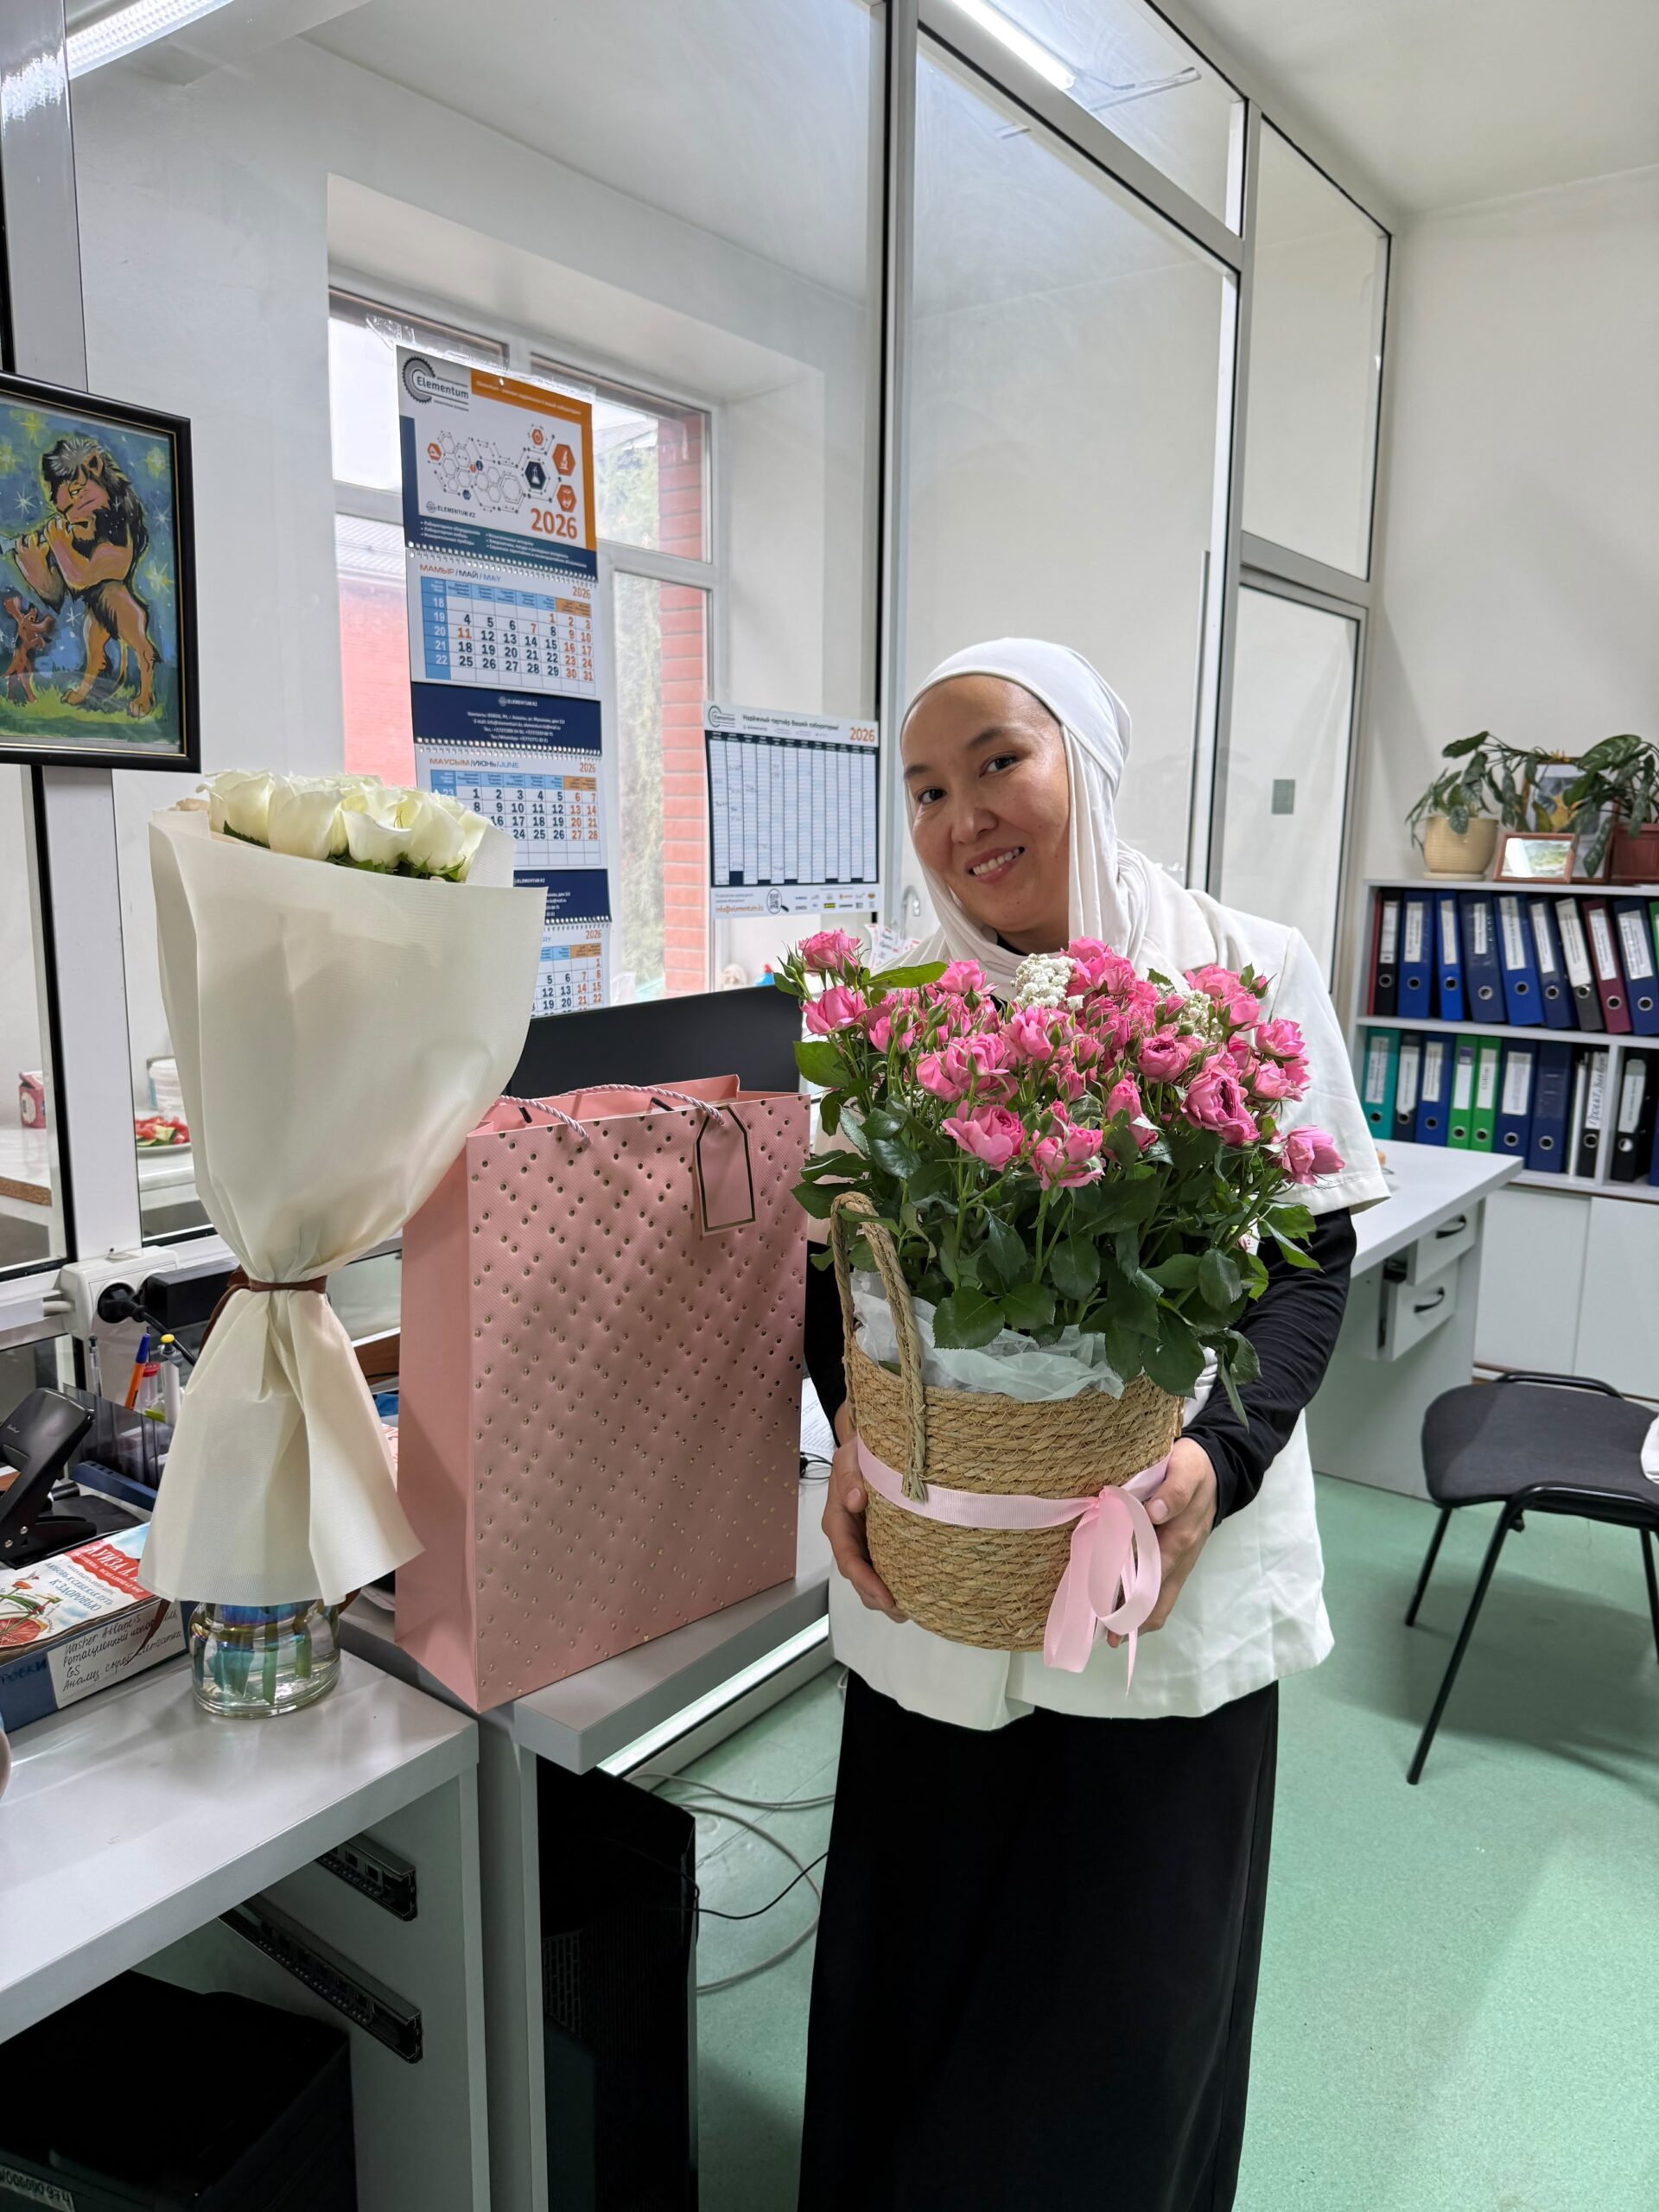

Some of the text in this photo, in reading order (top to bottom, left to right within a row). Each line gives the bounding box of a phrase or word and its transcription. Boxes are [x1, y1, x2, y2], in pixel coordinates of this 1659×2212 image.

[417, 377, 468, 399] Elementum
[437, 505, 475, 518] ELEMENTUM.KZ
[531, 508, 577, 539] 2026
[420, 564, 454, 574] МАМЫР
[573, 587, 591, 598] 2026
[433, 597, 590, 630] 18 1 2 3
[434, 612, 591, 643] 19 4 5 6 7 8 9 10
[435, 626, 592, 656] 20 11 12 13 14 15 16 17
[435, 640, 592, 668] 21 18 19 20 21 22 23 24
[436, 654, 594, 681] 22 25 26 27 28 29 30 31
[849, 728, 875, 742] 2026
[580, 763, 596, 772] 2026
[474, 789, 480, 798] 1
[496, 790, 502, 799] 2
[518, 790, 523, 799] 3
[537, 790, 543, 800] 4
[557, 791, 563, 800] 5
[575, 792, 580, 802] 6
[591, 793, 596, 803] 7
[474, 802, 596, 815] 8 9 10 11 12 13 14
[512, 817, 524, 826] 17
[533, 817, 545, 826] 18
[553, 817, 564, 826] 19
[571, 817, 581, 827] 20
[588, 818, 597, 827] 21
[513, 830, 598, 840] 24 25 26 27 28
[586, 930, 602, 939] 2026
[596, 958, 601, 968] 1
[548, 974, 553, 984] 5
[565, 973, 570, 982] 6
[597, 969, 601, 978] 8
[543, 988, 553, 997] 12
[561, 986, 571, 995] 13
[577, 984, 587, 993] 14
[543, 1001, 554, 1009] 19
[562, 998, 571, 1007] 20
[85, 1544, 130, 1571] ЛУИЗА
[71, 1580, 89, 1591] СЕБЕ
[55, 1582, 102, 1611] ЗДОРОВЬЮ
